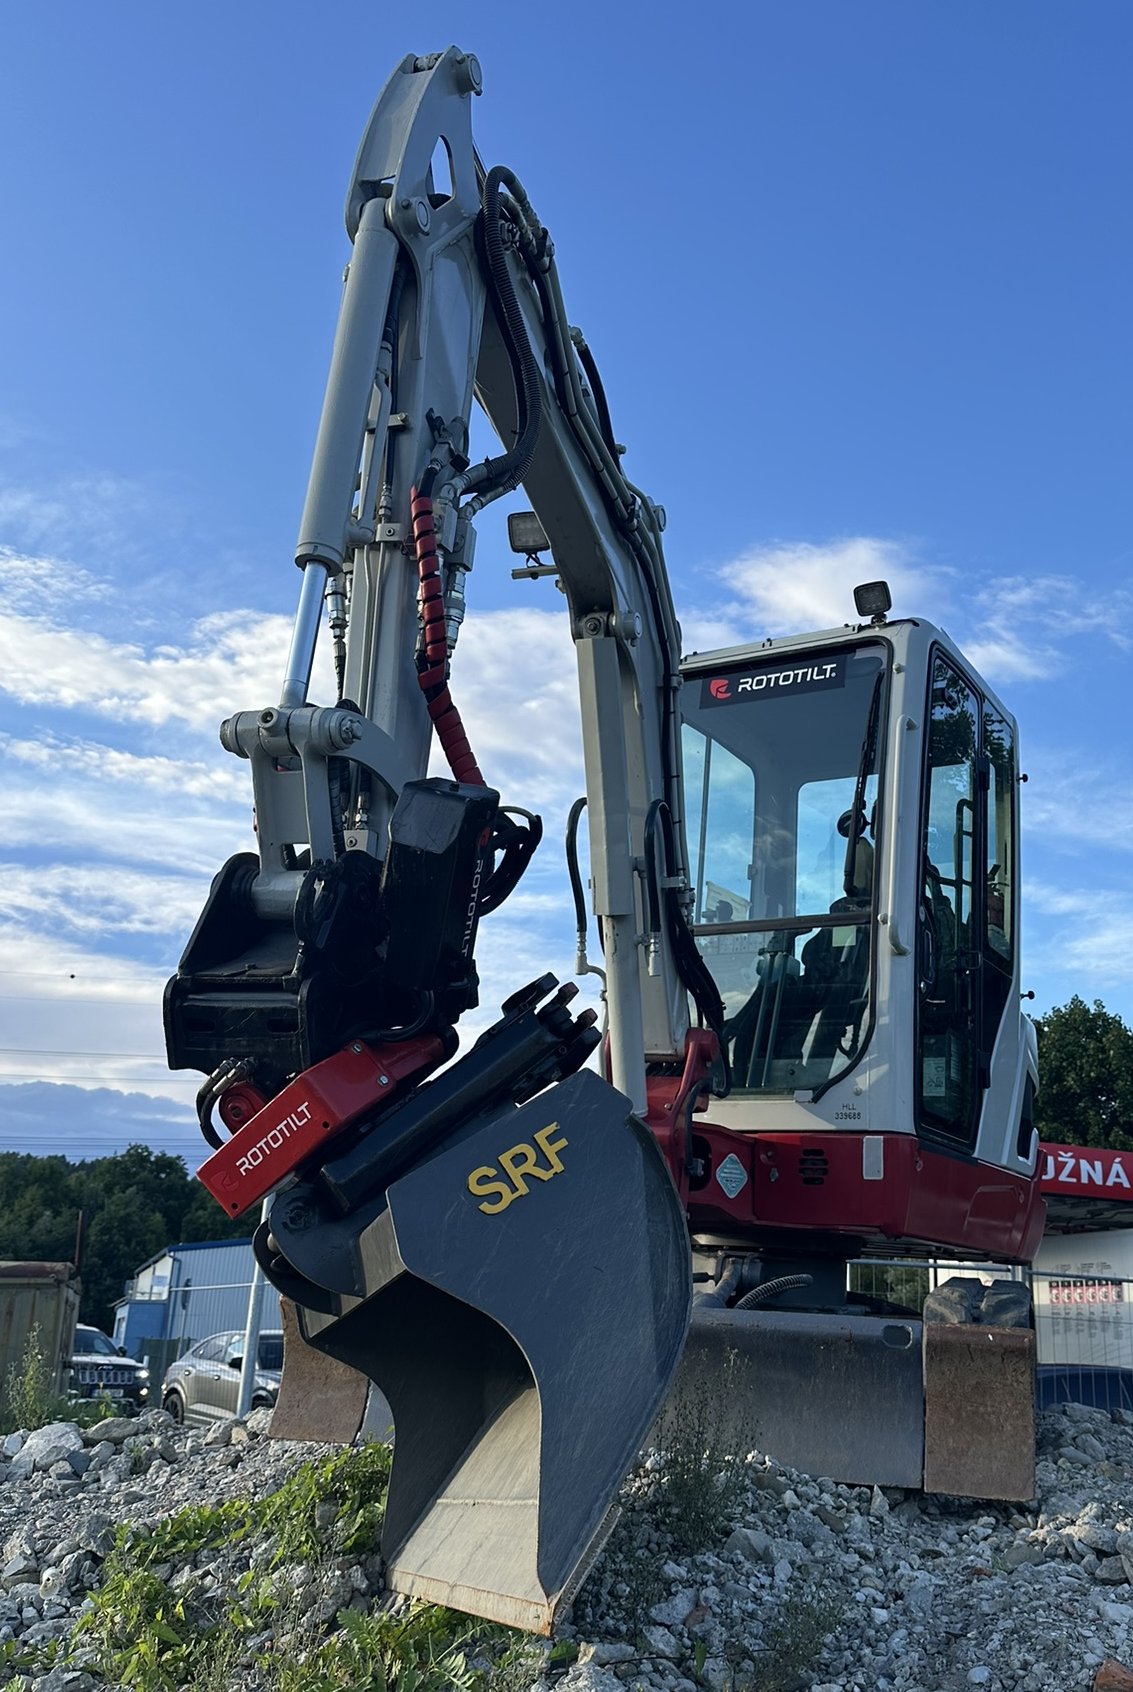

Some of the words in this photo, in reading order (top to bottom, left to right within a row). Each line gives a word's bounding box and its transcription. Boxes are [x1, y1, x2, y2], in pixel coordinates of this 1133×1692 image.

[462, 859, 483, 957] ROTOTILT
[236, 1101, 312, 1176] ROTOTILT
[467, 1121, 569, 1215] SRF
